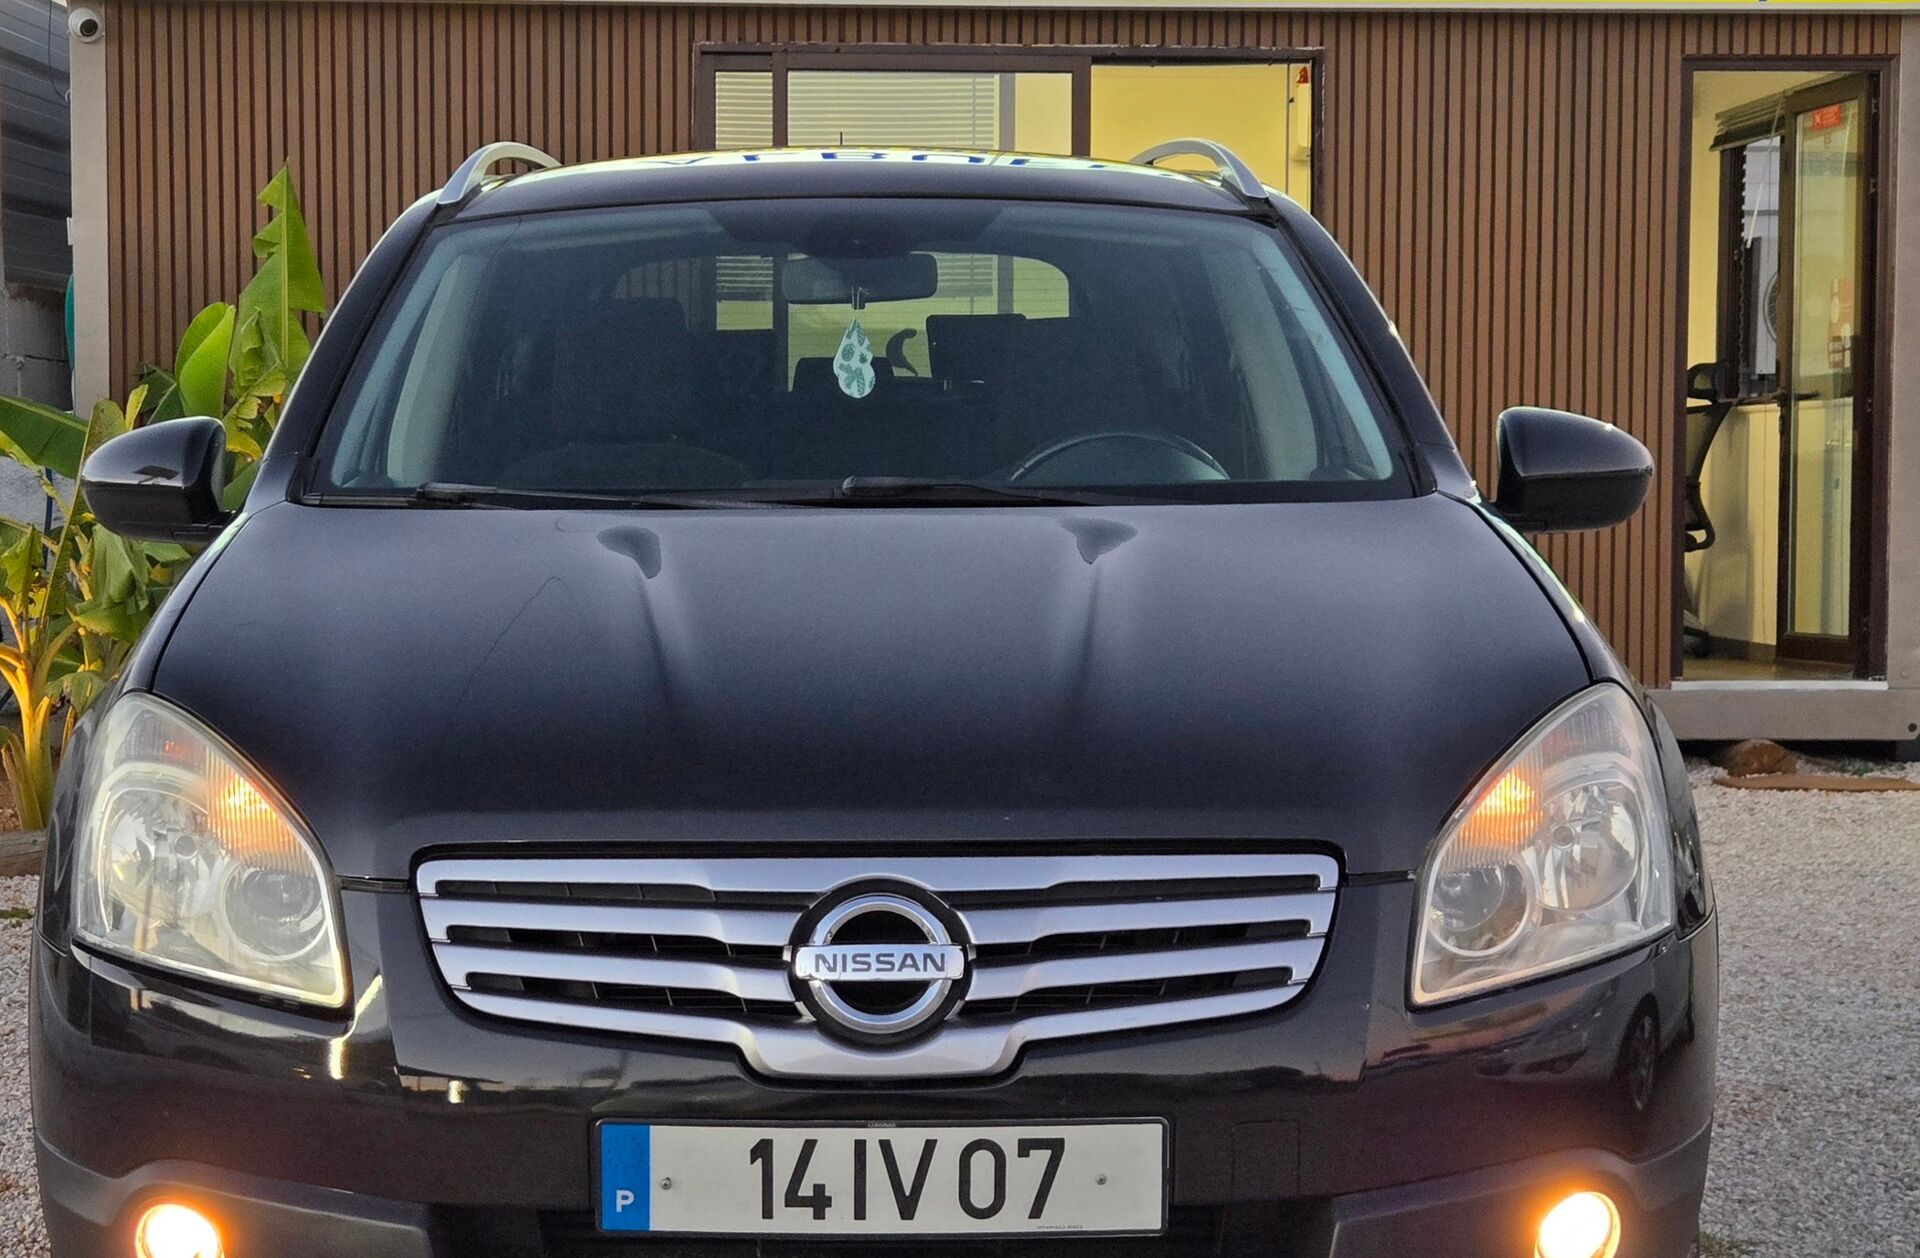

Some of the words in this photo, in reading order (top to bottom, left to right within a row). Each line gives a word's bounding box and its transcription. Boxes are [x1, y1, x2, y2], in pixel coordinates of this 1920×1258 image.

[814, 952, 946, 973] NISSAN
[750, 1138, 832, 1220] 14
[854, 1138, 938, 1220] IV
[958, 1137, 1066, 1220] 07
[616, 1190, 635, 1213] P
